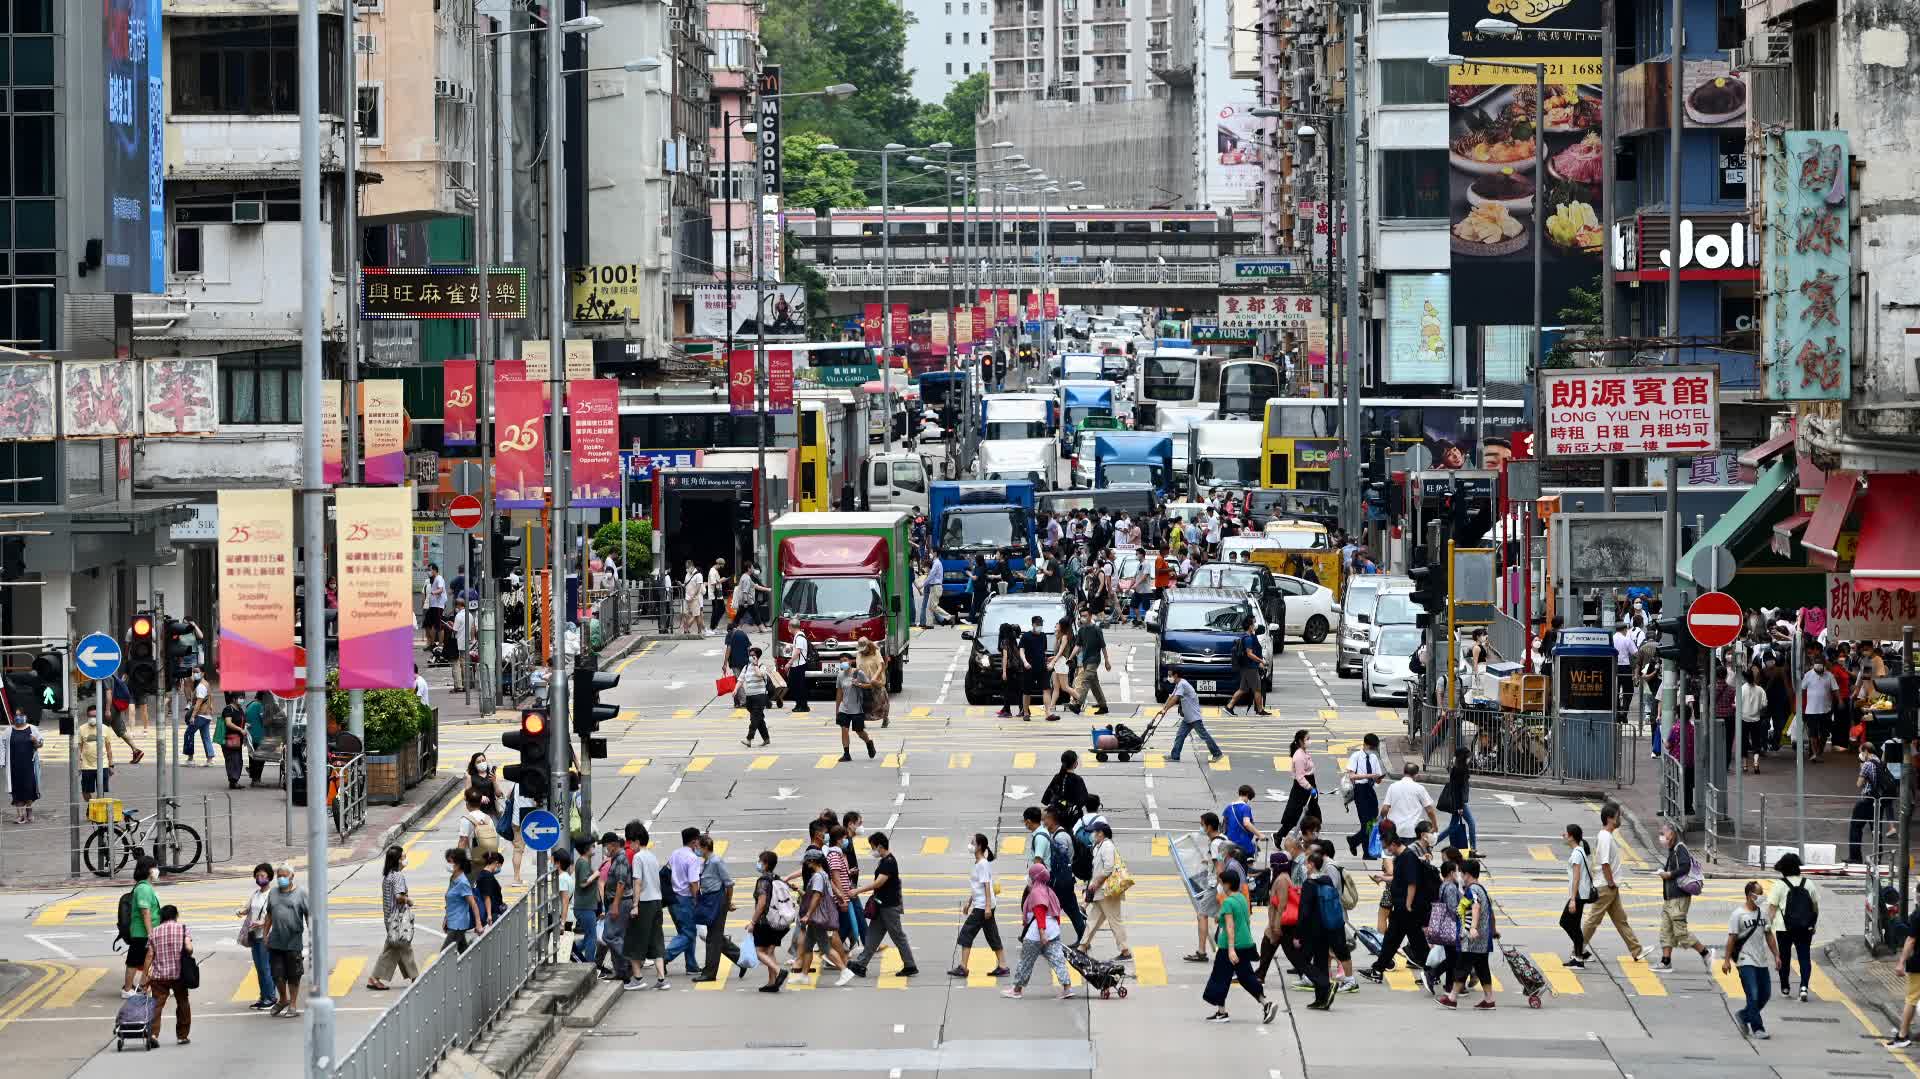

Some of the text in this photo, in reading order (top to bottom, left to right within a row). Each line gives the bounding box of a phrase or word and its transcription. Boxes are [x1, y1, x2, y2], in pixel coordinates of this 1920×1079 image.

[1458, 64, 1482, 76] 3/F
[1572, 64, 1603, 75] 1688
[574, 264, 637, 286] $100!
[1257, 265, 1285, 274] YONEX
[1226, 296, 1312, 314] 皇都賓館
[1551, 376, 1709, 409] 朗源賓館
[1552, 408, 1711, 424] LONG YUEN HOTEL
[1551, 422, 1709, 440] 時租 日租 月租均可
[1557, 441, 1659, 454] 新亞大廈一樓
[1571, 670, 1603, 683] Wi-Fi
